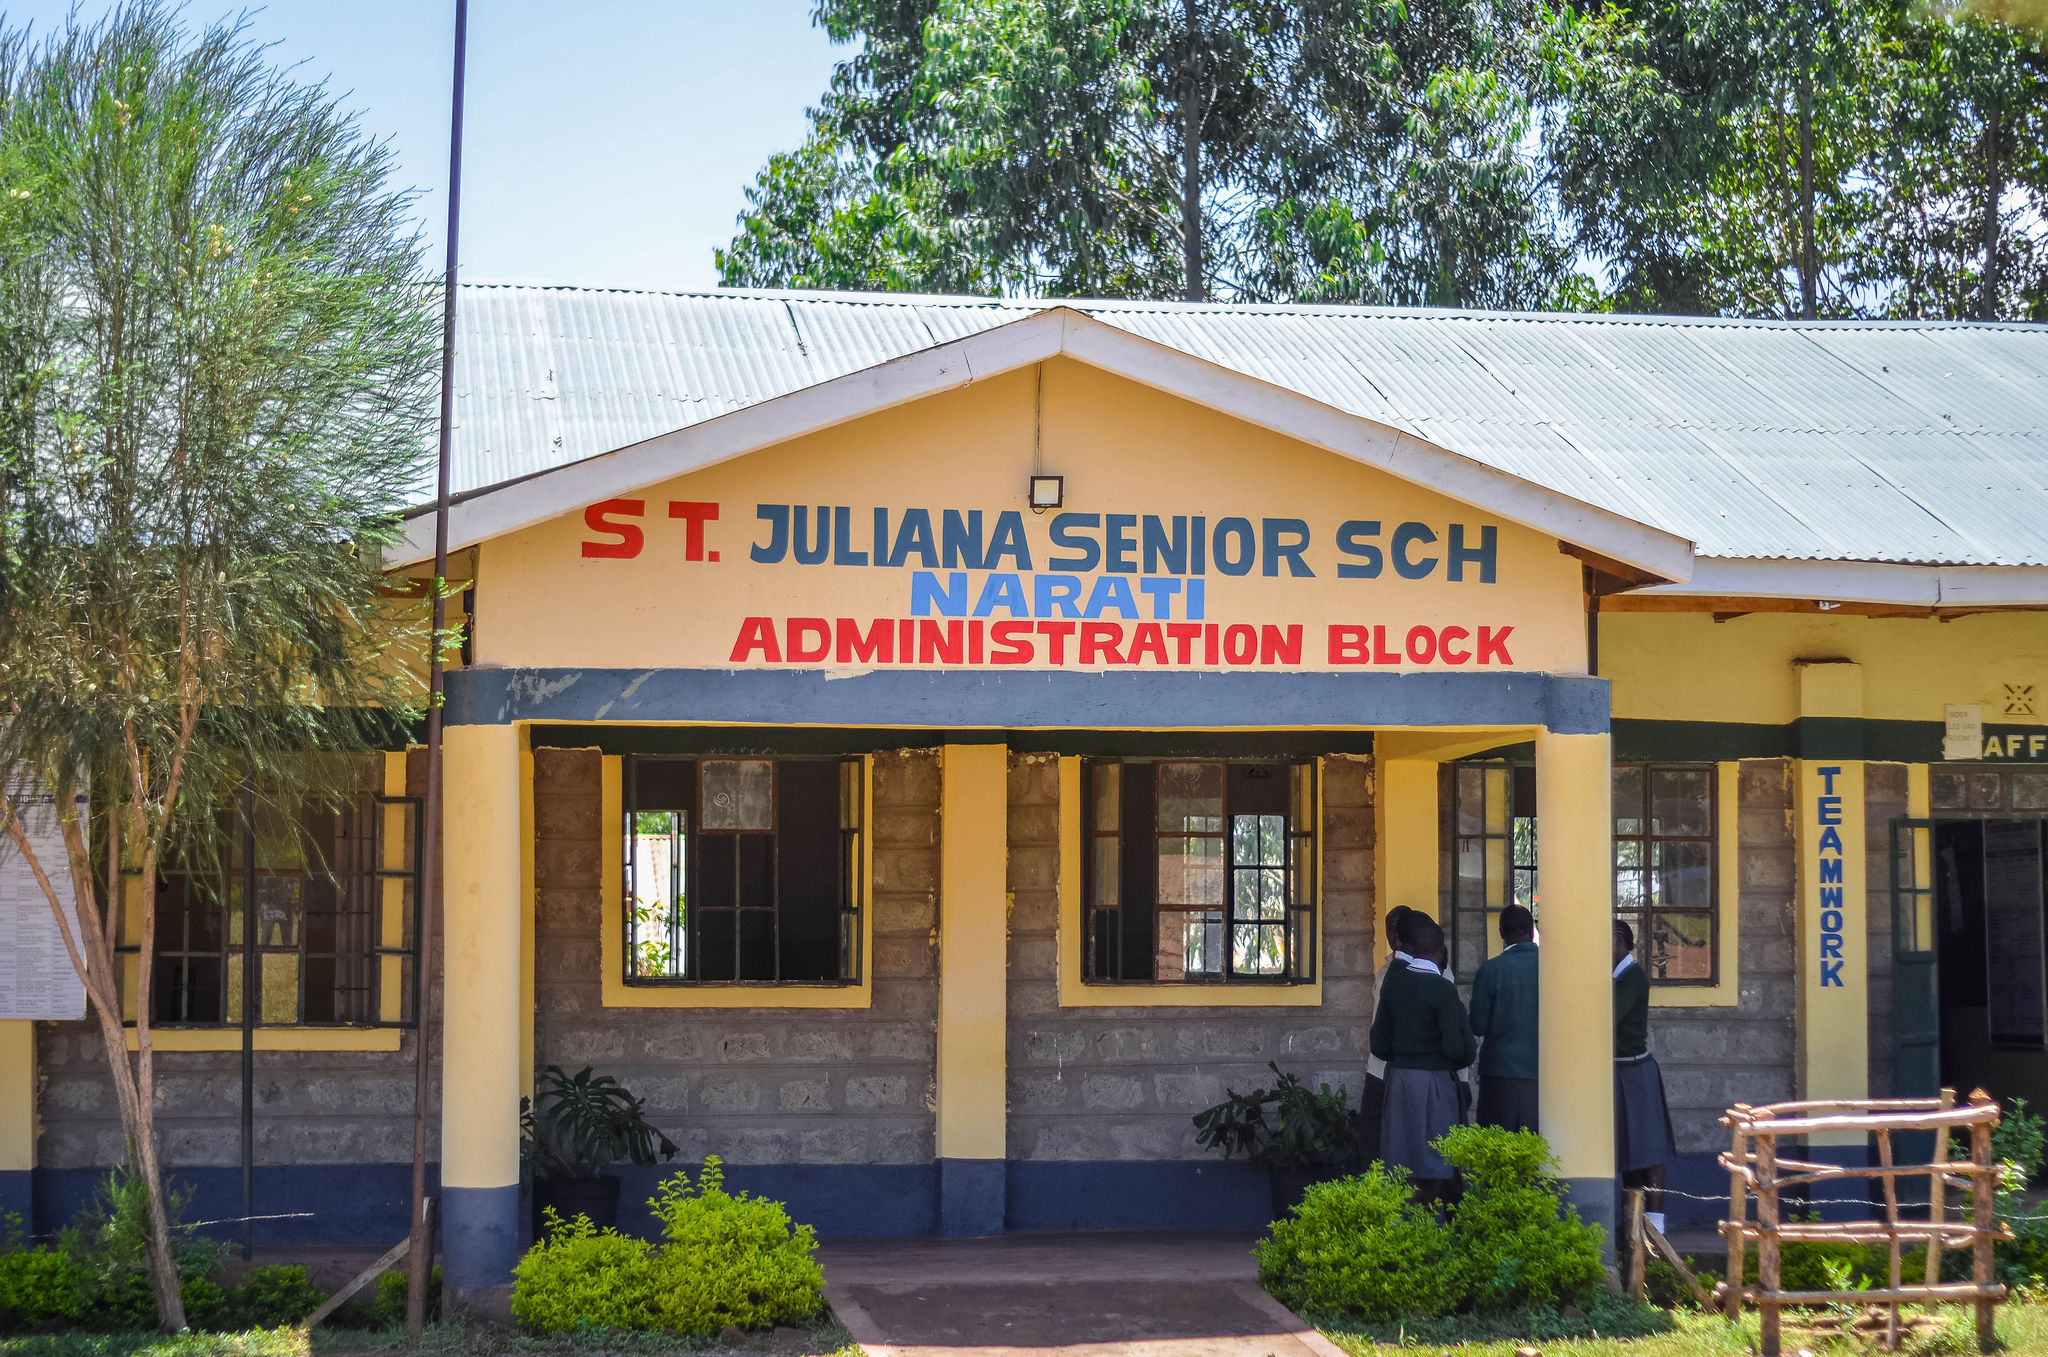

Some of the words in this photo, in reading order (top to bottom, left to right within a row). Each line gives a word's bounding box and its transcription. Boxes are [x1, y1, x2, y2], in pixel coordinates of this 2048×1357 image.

[581, 498, 721, 563] ST.
[749, 504, 1034, 571] JULIANA
[1048, 512, 1317, 578] SENIOR
[1336, 520, 1498, 584] SCH
[911, 571, 1206, 620] NARATI
[728, 616, 1304, 666] ADMINISTRATION
[1327, 624, 1516, 666] BLOCK
[1816, 766, 1845, 988] TEAMWORK
